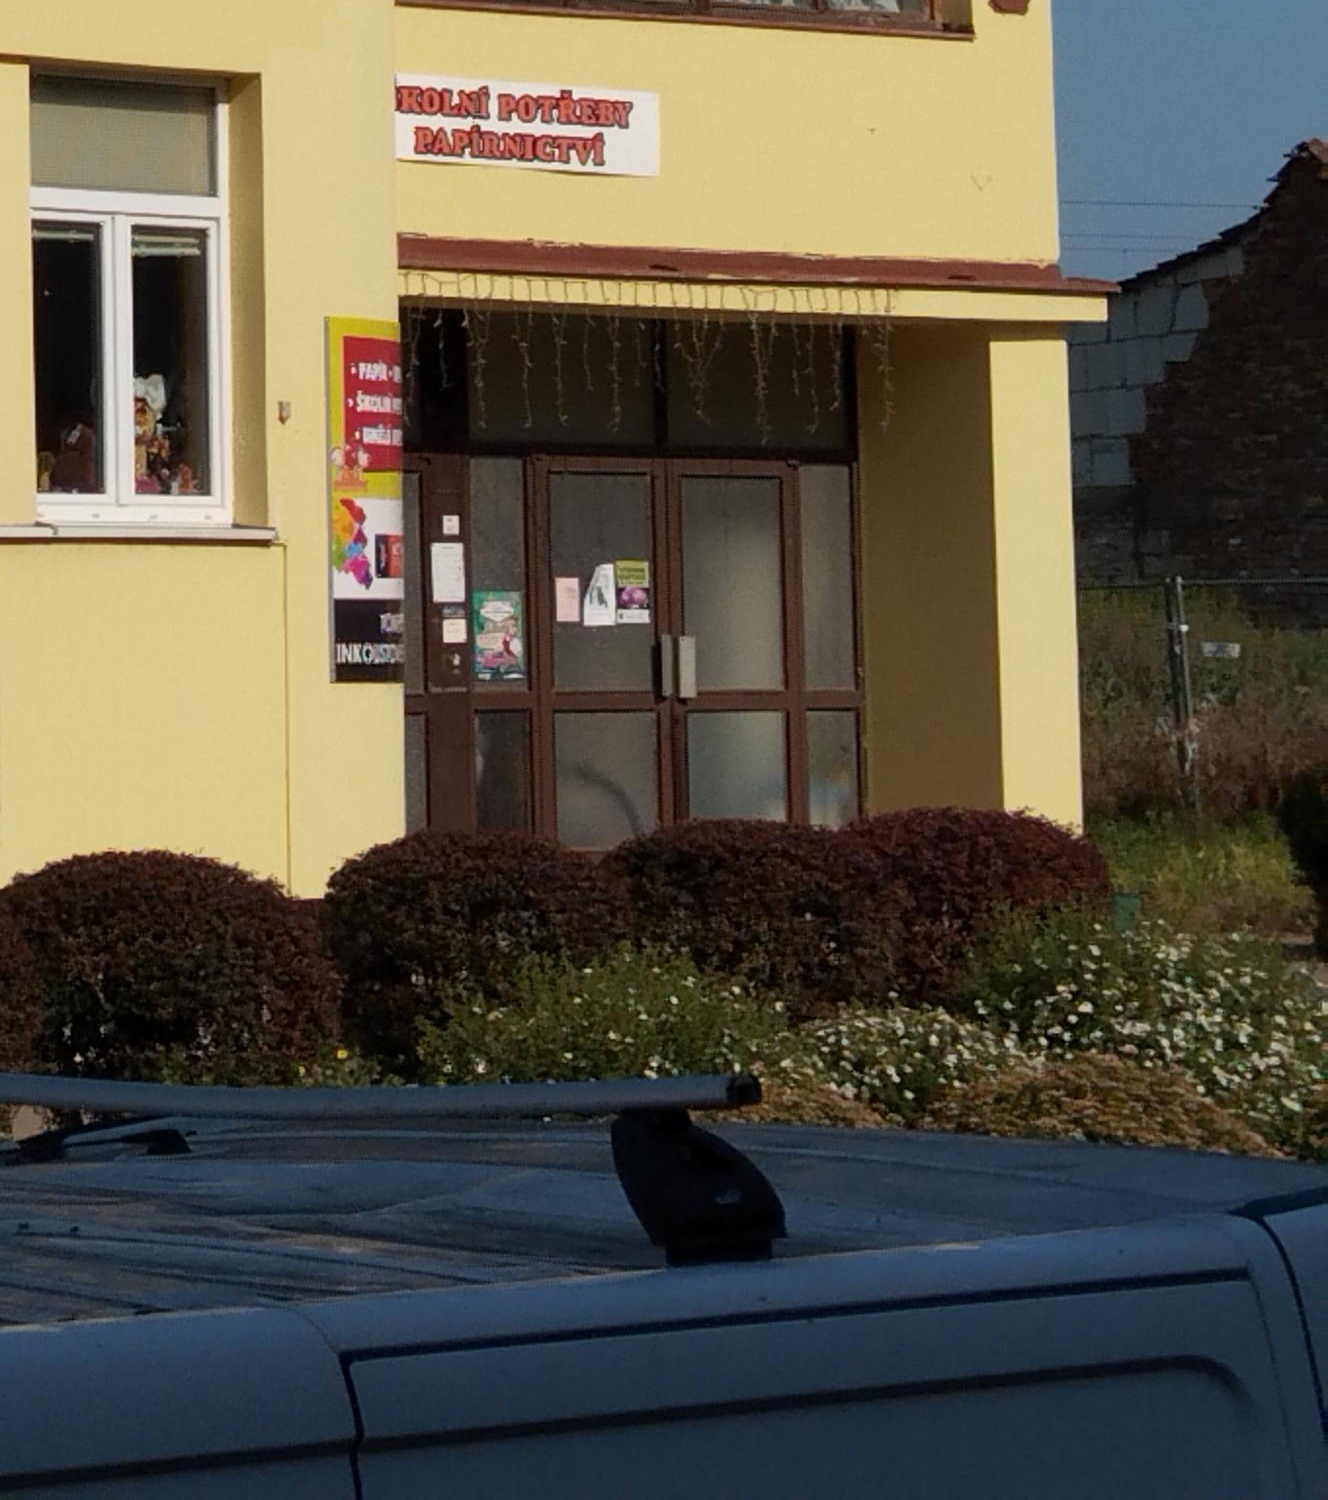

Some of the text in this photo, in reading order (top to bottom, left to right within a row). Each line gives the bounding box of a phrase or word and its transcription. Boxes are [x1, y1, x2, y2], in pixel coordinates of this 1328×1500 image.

[395, 85, 633, 129] KOLNÍ POTŘEBY
[414, 122, 605, 166] PAPÍRNICTVÍ
